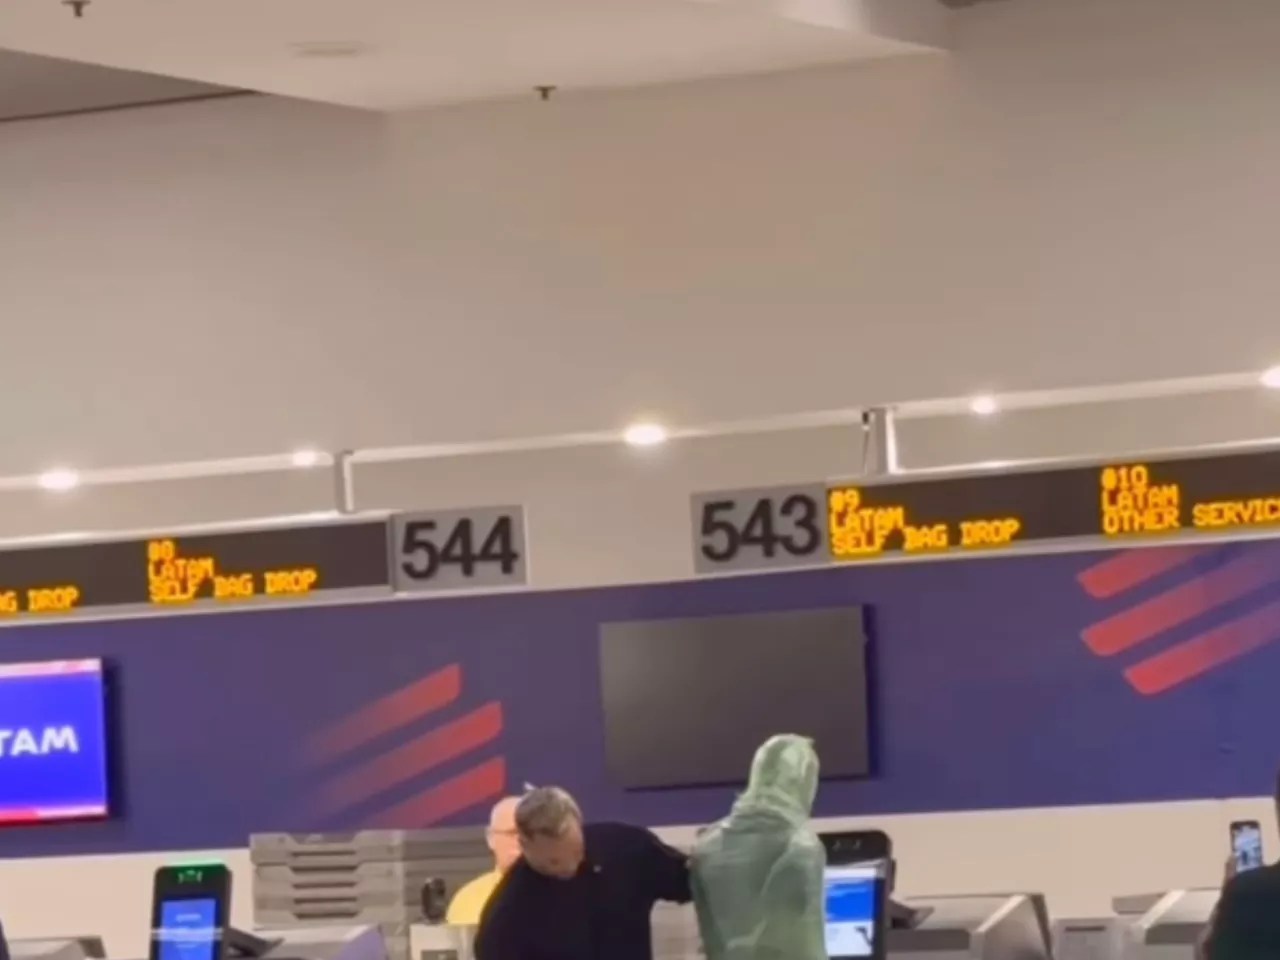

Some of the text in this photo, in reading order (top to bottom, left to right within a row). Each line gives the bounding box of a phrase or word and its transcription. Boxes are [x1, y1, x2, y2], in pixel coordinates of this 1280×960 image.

[1102, 484, 1179, 513] LATAM
[701, 493, 821, 562] 543
[831, 506, 905, 536] LATAM
[832, 517, 1020, 555] SELF BAG DROP
[1103, 508, 1180, 534] OTHER
[401, 515, 520, 580] 544
[148, 557, 215, 583] LATAM
[214, 574, 253, 598] BAG
[264, 568, 317, 594] DROP
[27, 586, 79, 612] DROP
